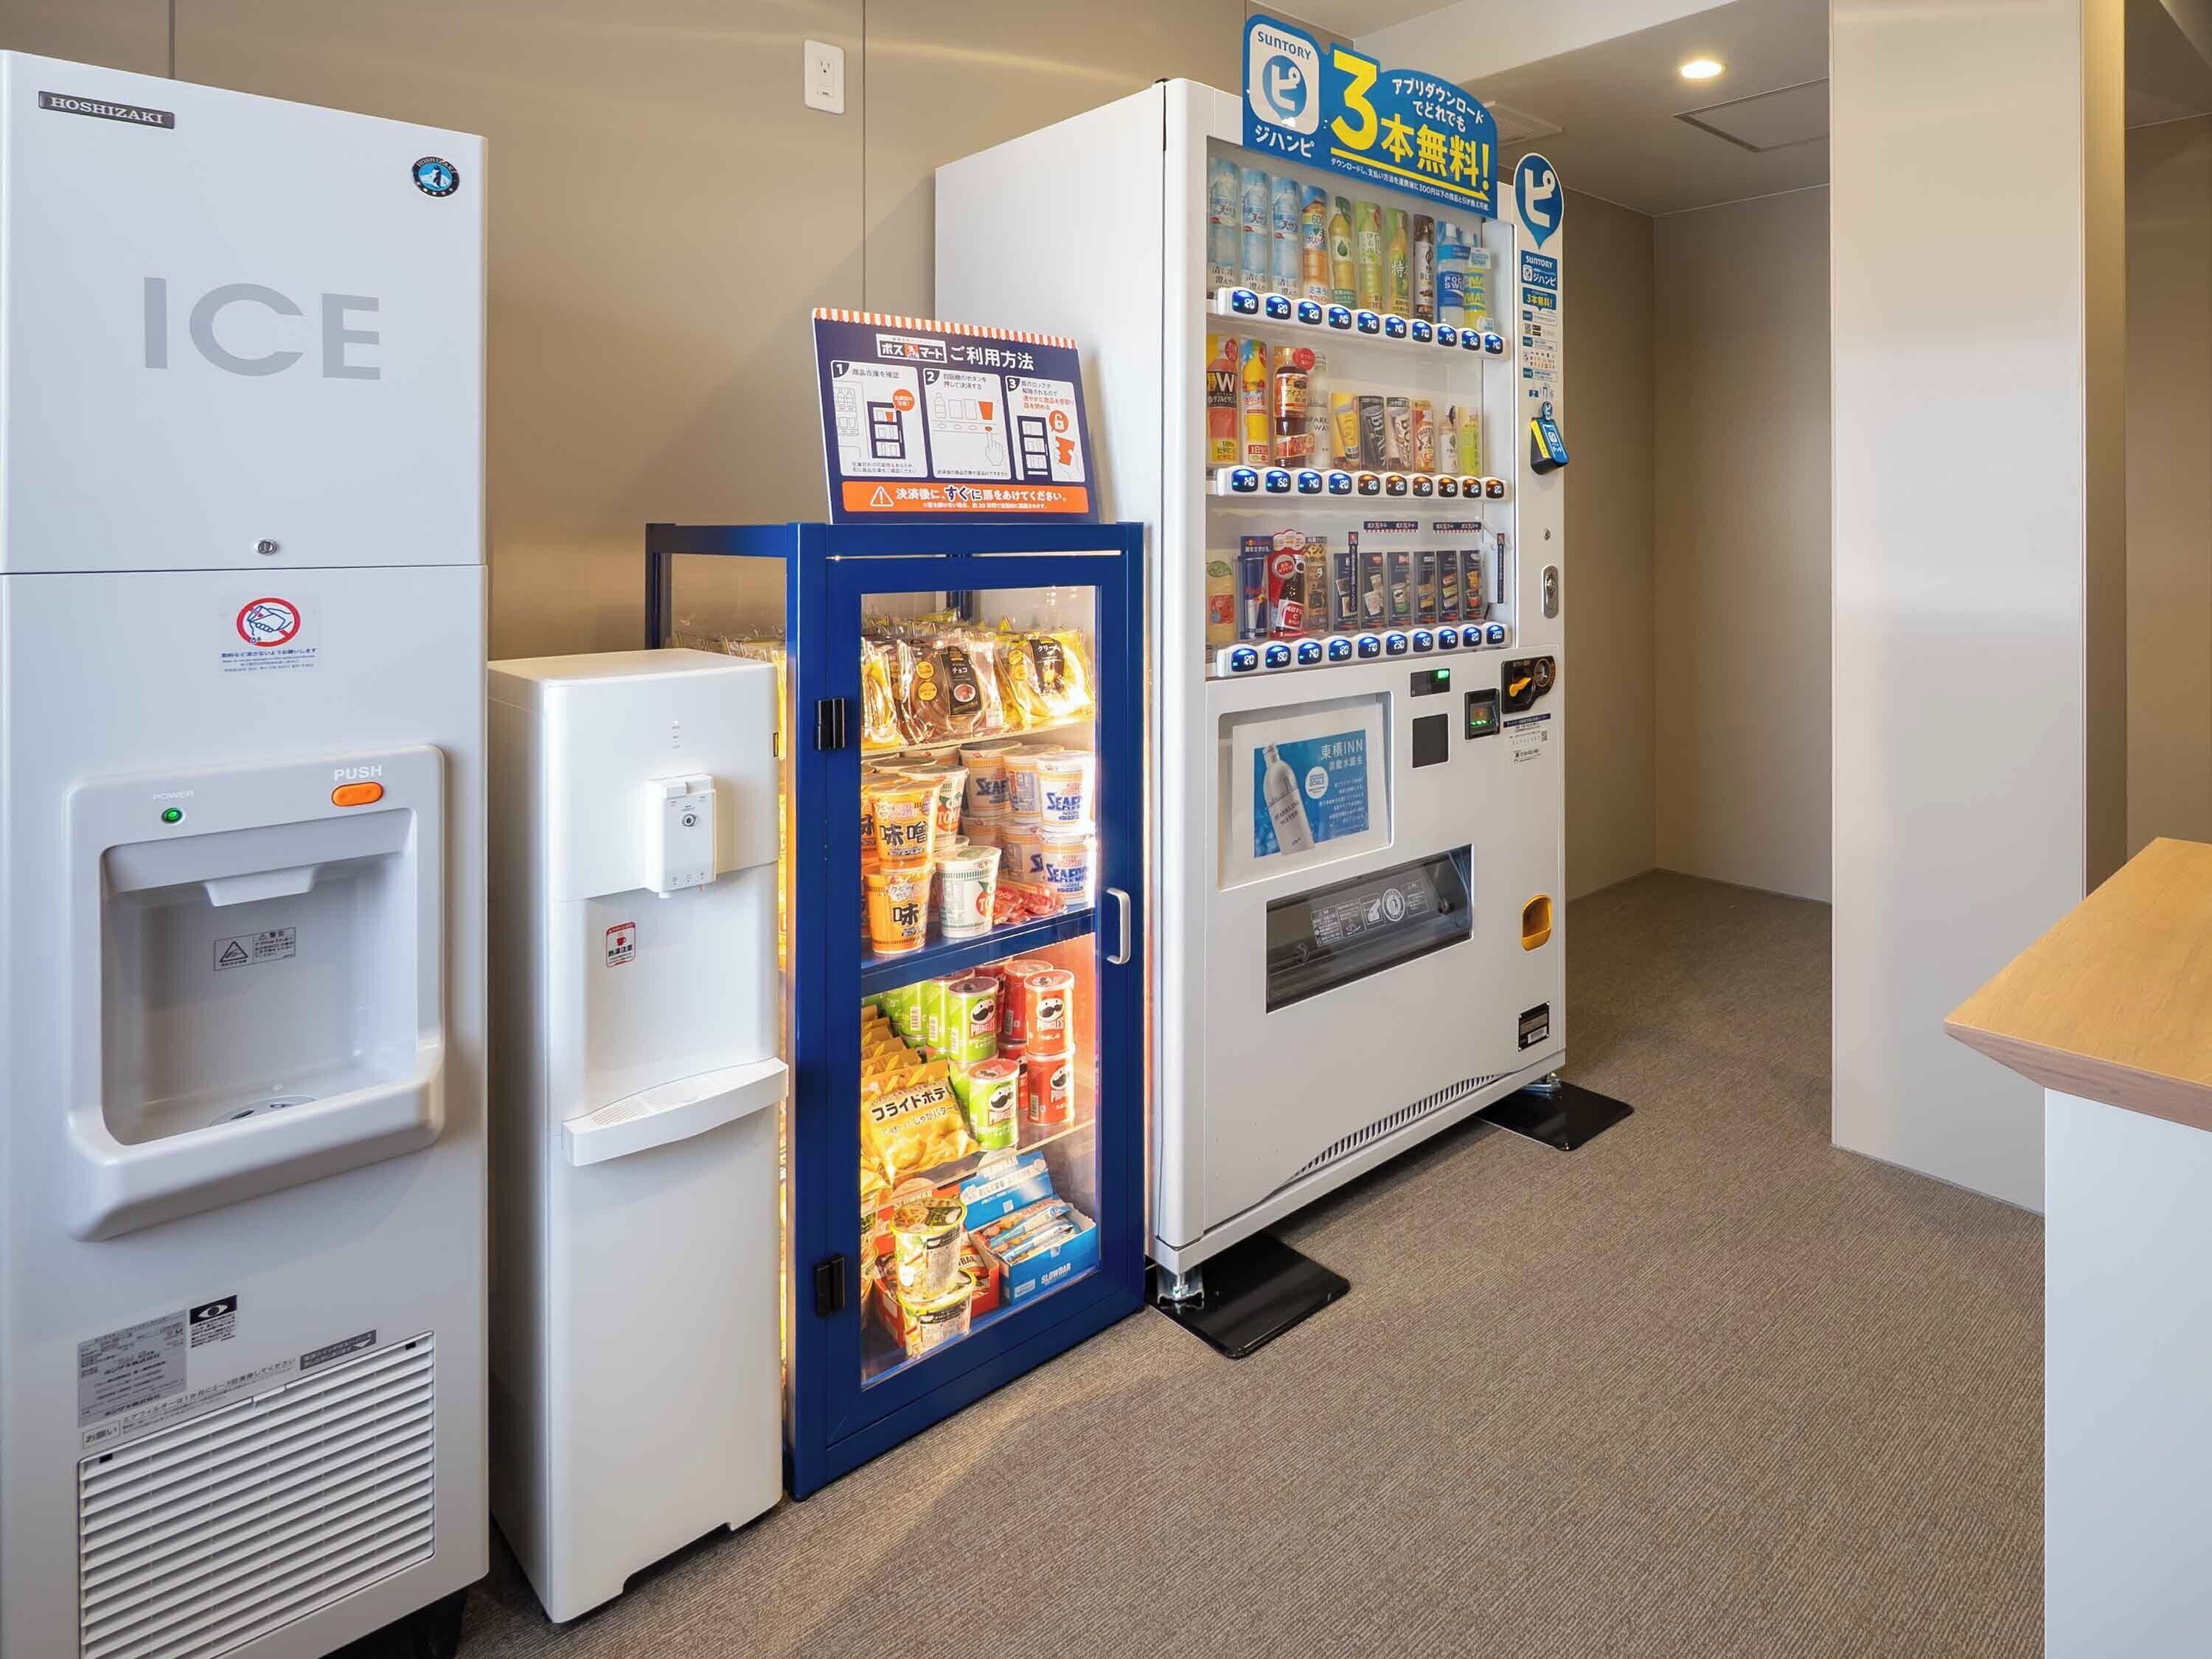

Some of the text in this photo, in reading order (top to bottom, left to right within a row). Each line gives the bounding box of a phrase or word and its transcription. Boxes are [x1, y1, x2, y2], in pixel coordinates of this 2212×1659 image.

[1257, 29, 1312, 61] SUNTORY
[50, 95, 164, 125] HOSHIZAKI
[1391, 77, 1485, 125] アプリダウンロード
[1412, 100, 1467, 132] でどれでも
[1253, 123, 1315, 159] ジハンピ
[1525, 255, 1553, 269] SUNTORY
[1533, 273, 1557, 287] ジハンピ
[143, 276, 382, 380] ICE
[950, 345, 1035, 371] ご利用方法
[835, 363, 844, 375] 1
[926, 371, 936, 383] 2
[1008, 379, 1018, 389] 3
[1321, 737, 1364, 761] 東横INN
[333, 764, 384, 782] PUSH
[152, 790, 195, 801] POWER
[1040, 1263, 1071, 1284] SLOWBAR
[85, 1427, 118, 1443] お願い
